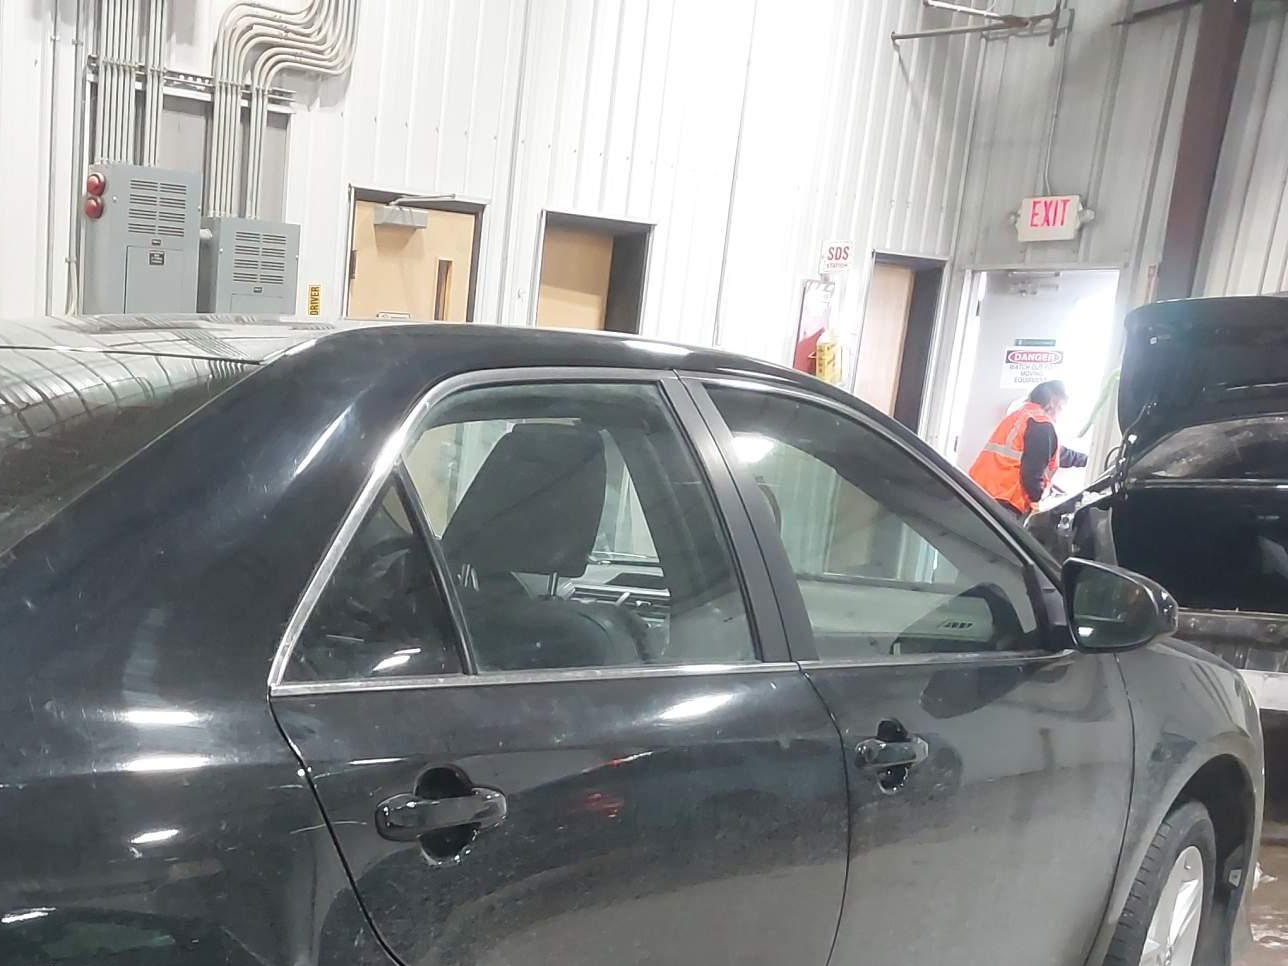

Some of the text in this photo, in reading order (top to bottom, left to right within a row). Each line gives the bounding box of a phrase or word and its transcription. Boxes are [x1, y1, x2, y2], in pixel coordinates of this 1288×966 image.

[1030, 198, 1071, 228] EXIT
[827, 246, 850, 261] SDS
[309, 286, 321, 316] DRIVER
[1013, 352, 1057, 363] DANGER
